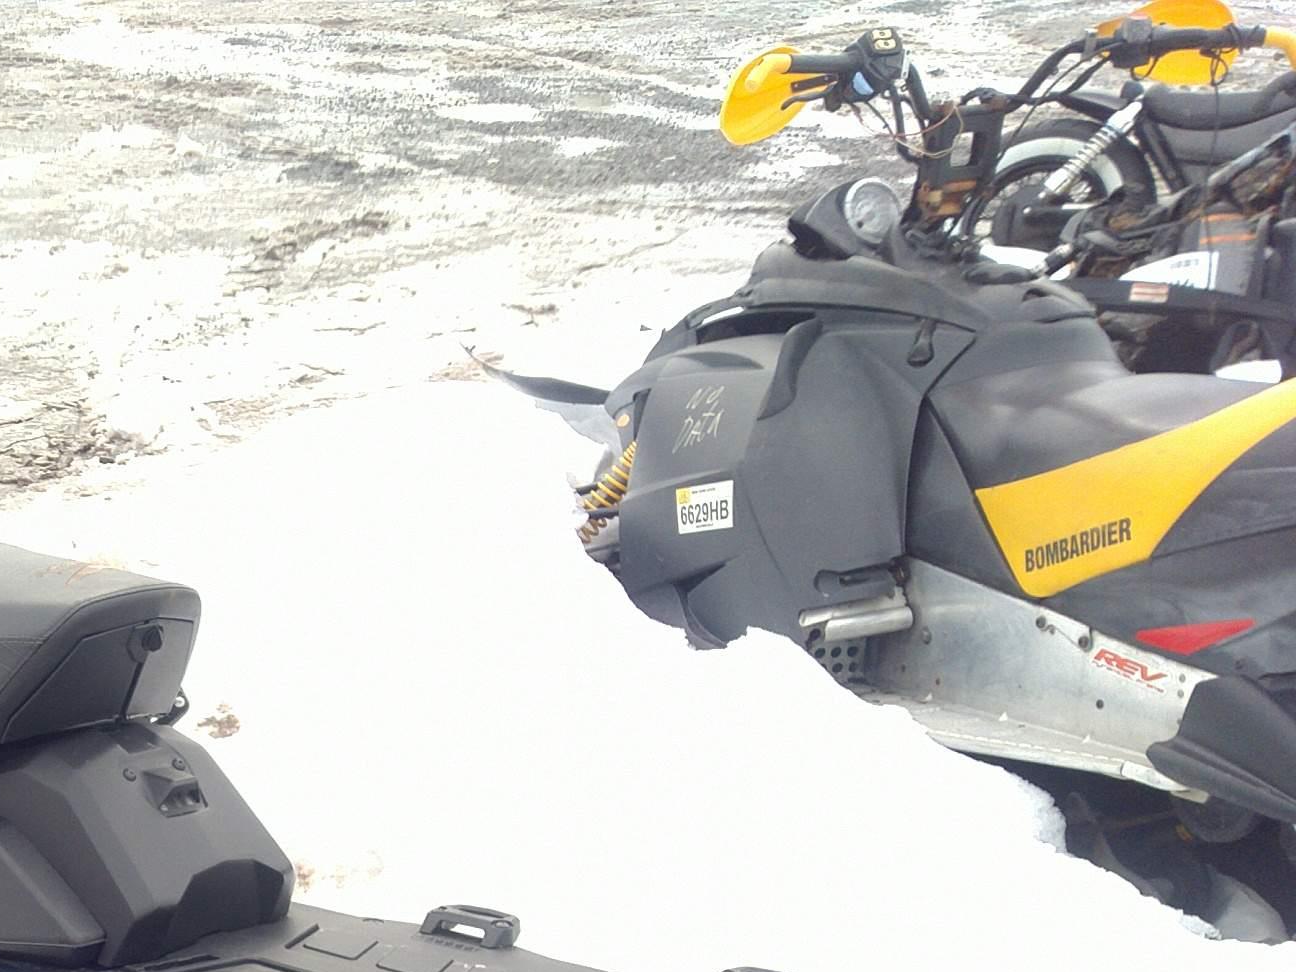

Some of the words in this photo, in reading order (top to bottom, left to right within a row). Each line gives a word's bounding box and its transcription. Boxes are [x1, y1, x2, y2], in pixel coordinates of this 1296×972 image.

[681, 499, 729, 525] 6629HB
[1024, 517, 1132, 573] BOMBARDIER
[1094, 648, 1168, 681] REV
